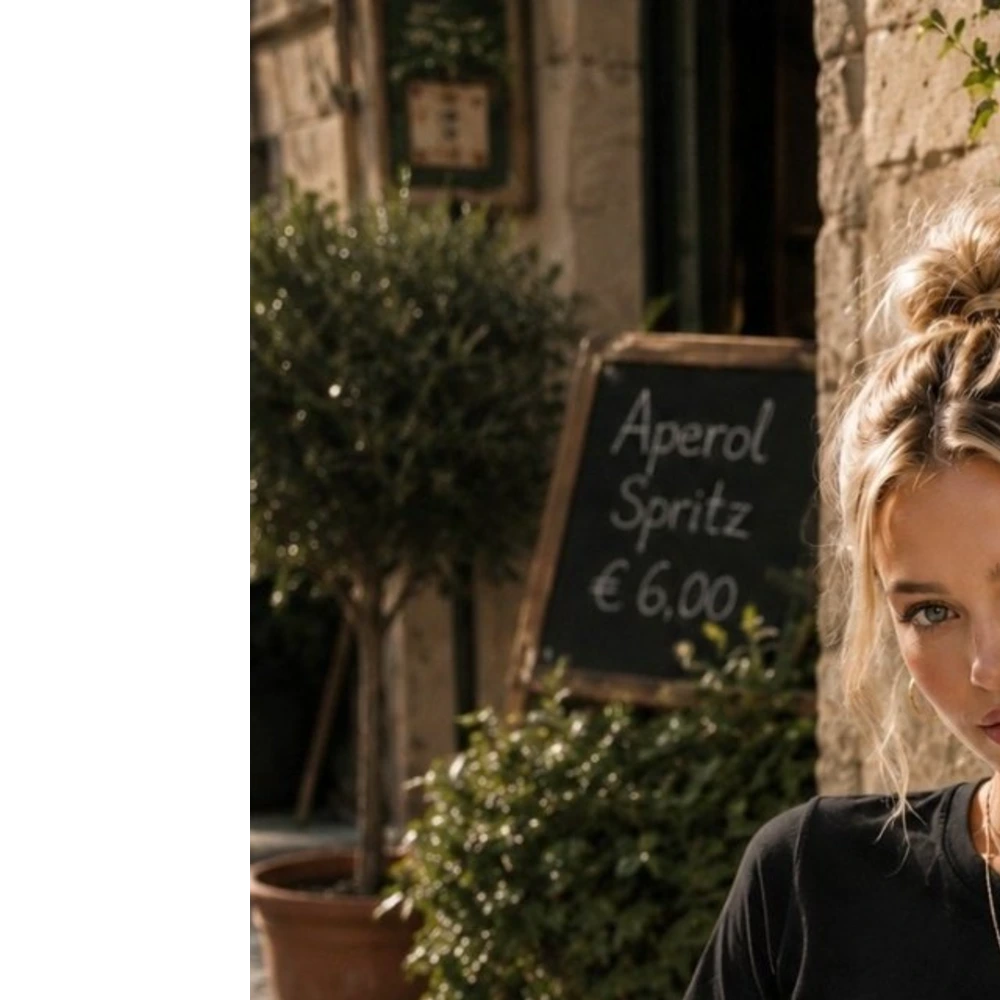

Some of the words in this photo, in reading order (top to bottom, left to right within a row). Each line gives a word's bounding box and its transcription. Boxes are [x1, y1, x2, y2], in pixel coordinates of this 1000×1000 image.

[610, 387, 775, 476] Aperol
[610, 473, 752, 553] Spritz
[590, 558, 630, 613] €
[637, 560, 739, 622] 6,00
